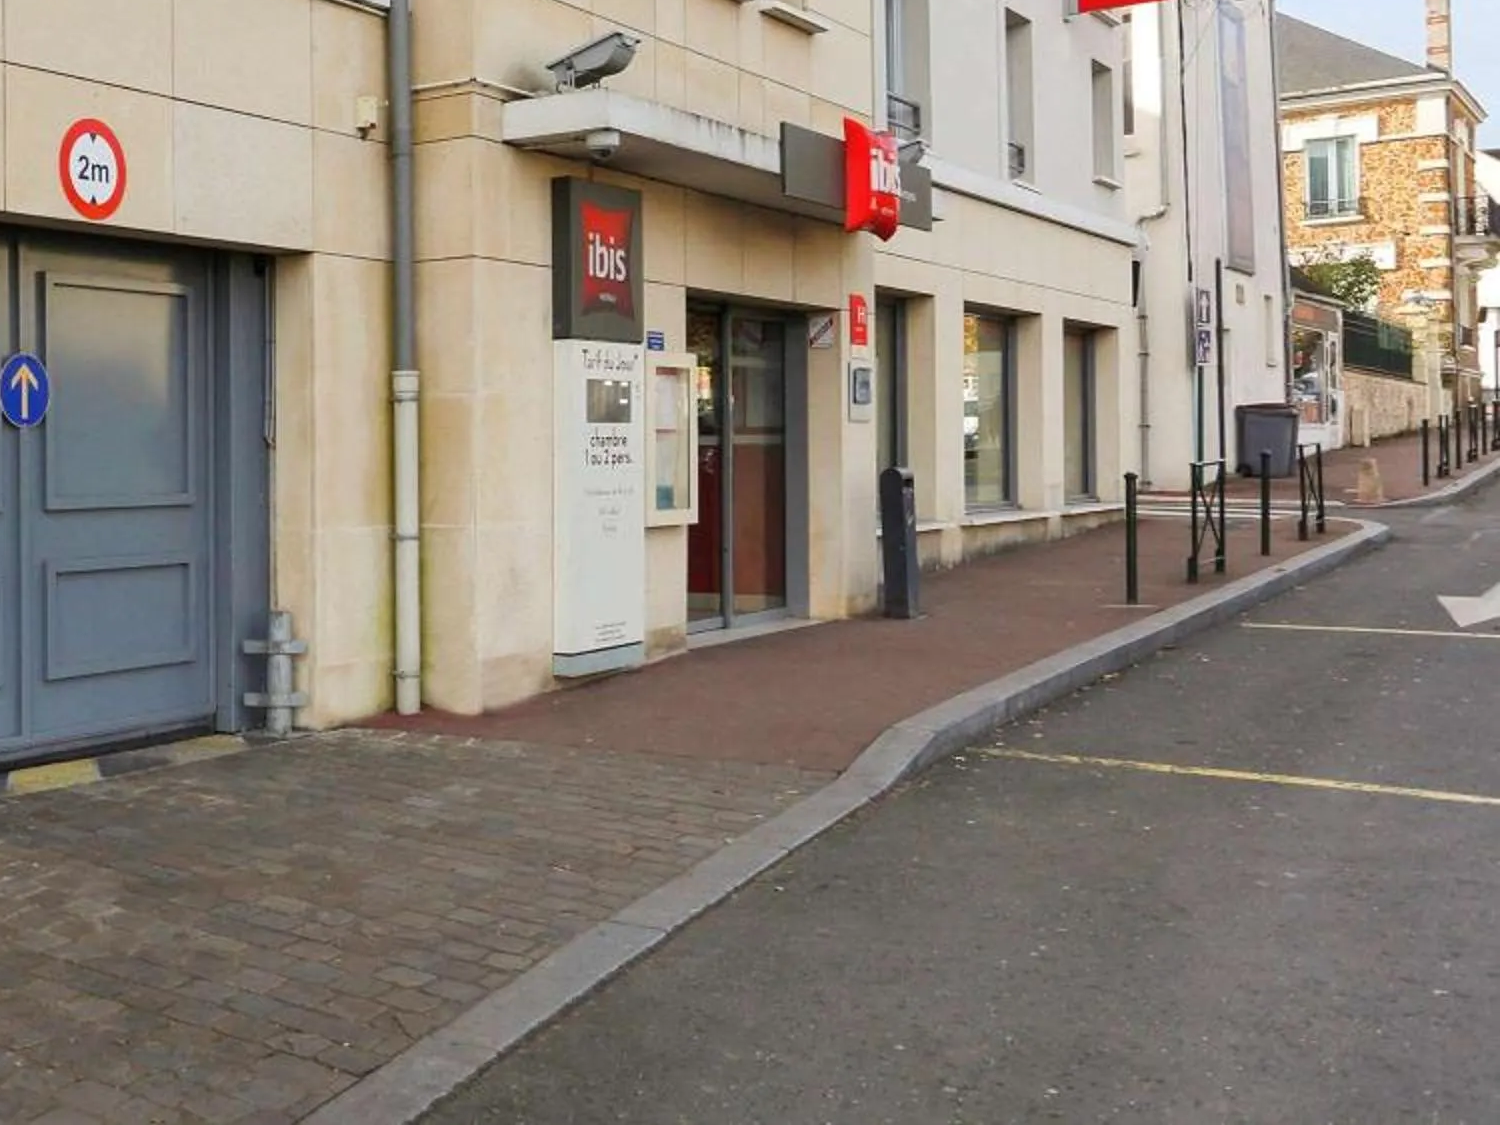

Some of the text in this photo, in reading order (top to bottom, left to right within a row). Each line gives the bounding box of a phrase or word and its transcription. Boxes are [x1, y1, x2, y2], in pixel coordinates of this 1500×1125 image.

[77, 155, 109, 183] 2m
[869, 148, 900, 196] ibis
[588, 232, 626, 281] ibis
[590, 427, 628, 448] chambre
